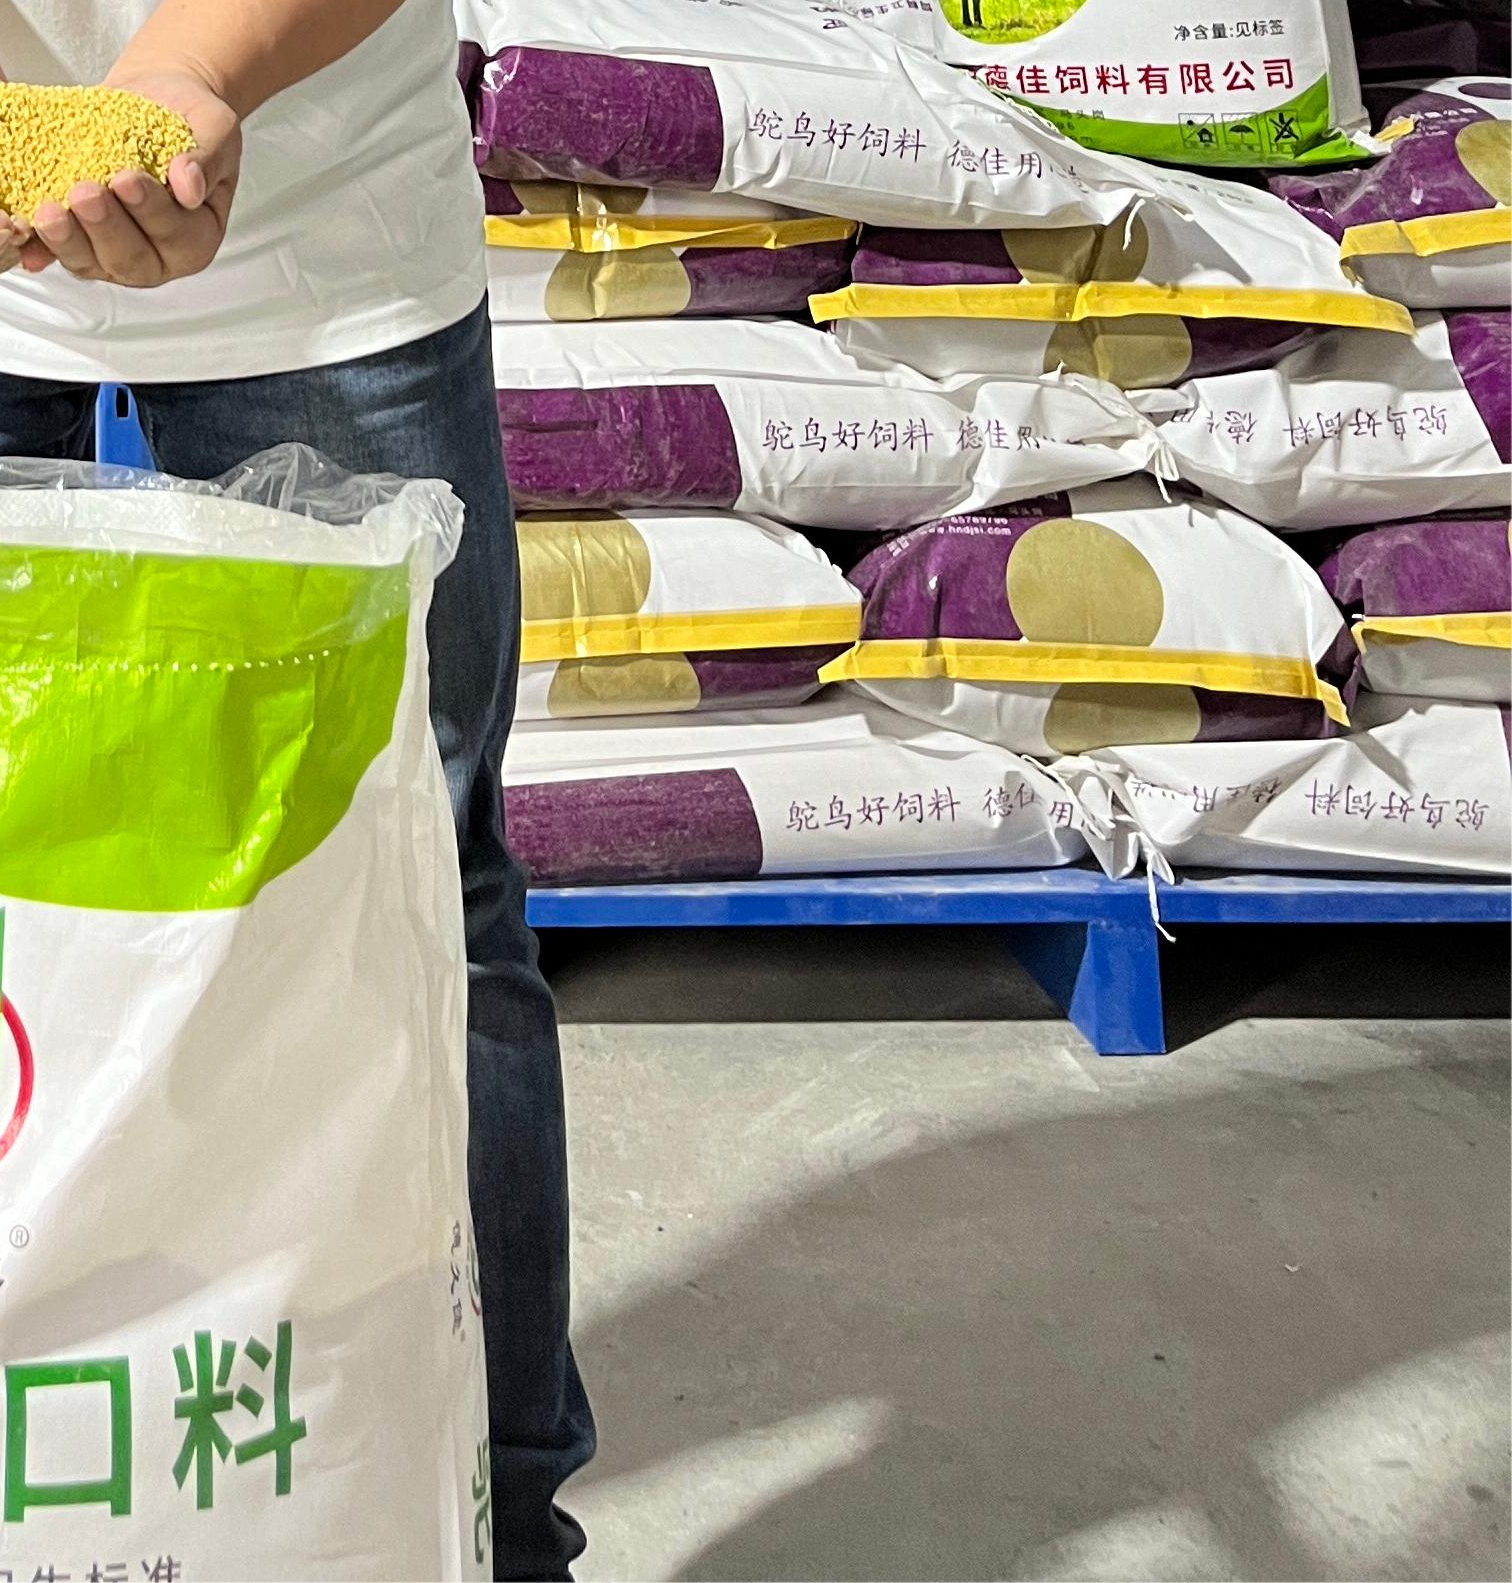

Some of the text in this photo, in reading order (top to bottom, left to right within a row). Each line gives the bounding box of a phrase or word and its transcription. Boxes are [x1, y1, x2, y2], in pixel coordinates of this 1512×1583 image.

[1173, 18, 1286, 42] 净含量:见标签
[748, 107, 928, 164] 鸵鸟好饲料
[762, 416, 935, 454] 鸵鸟好饲料
[1283, 403, 1447, 448] 鸵鸟好饲料
[785, 785, 962, 833] 鸵鸟好饲料
[1304, 778, 1490, 831] 鸵鸟好饲料
